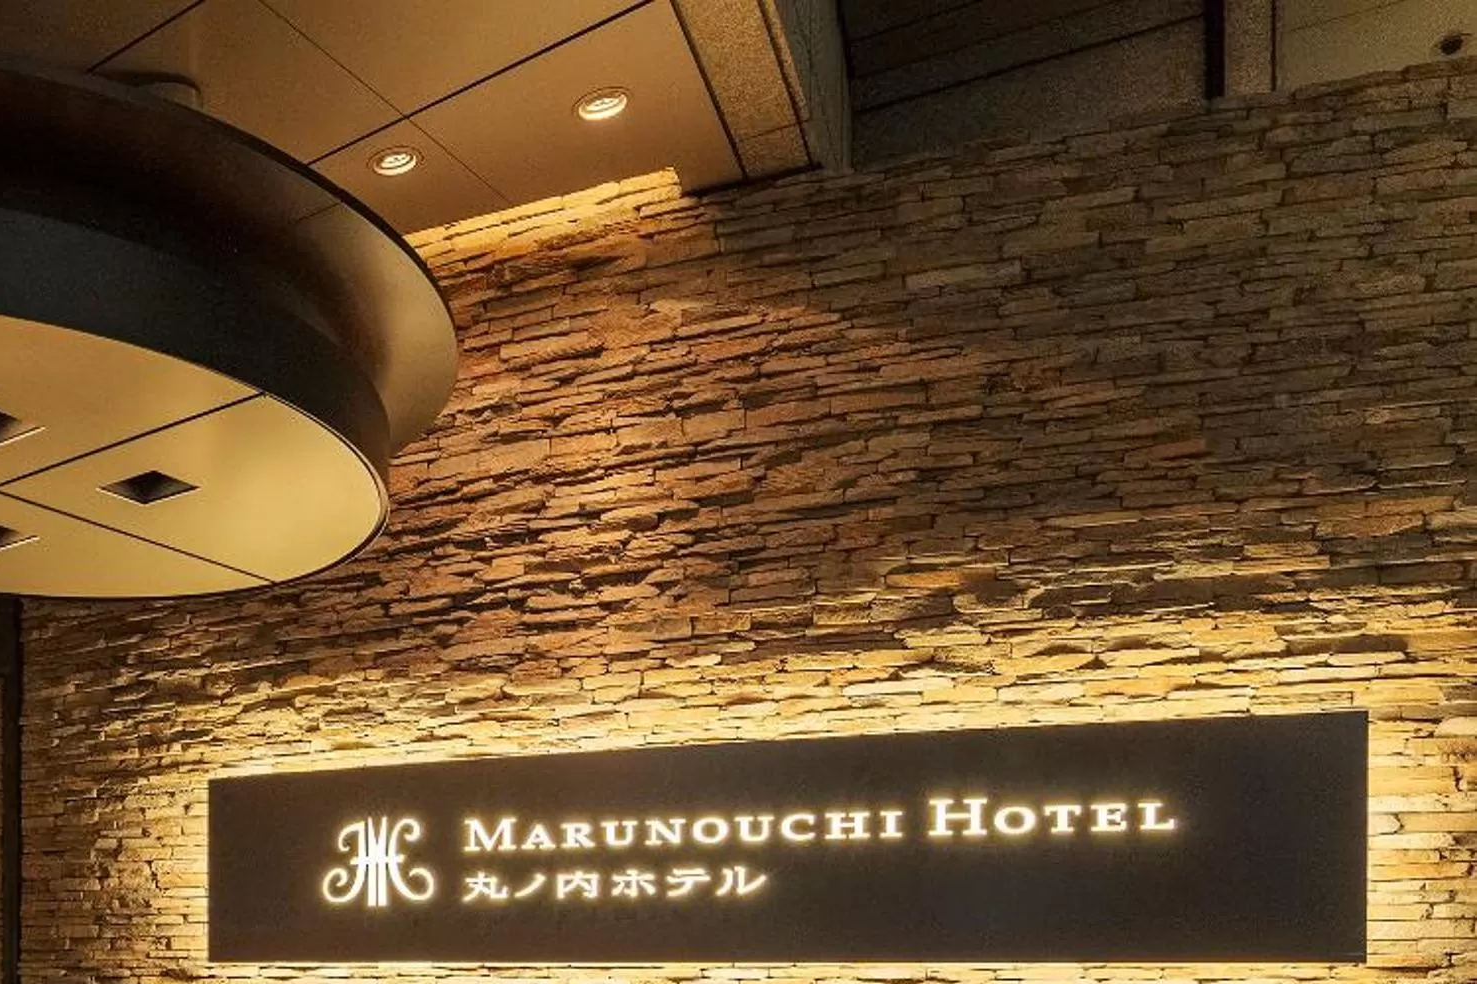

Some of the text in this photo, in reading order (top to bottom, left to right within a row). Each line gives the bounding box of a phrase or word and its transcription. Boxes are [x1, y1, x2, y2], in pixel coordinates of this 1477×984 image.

[463, 796, 1176, 852] MARUNOUCHI HOTEL
[462, 865, 767, 902] 丸ノ内ホテル
